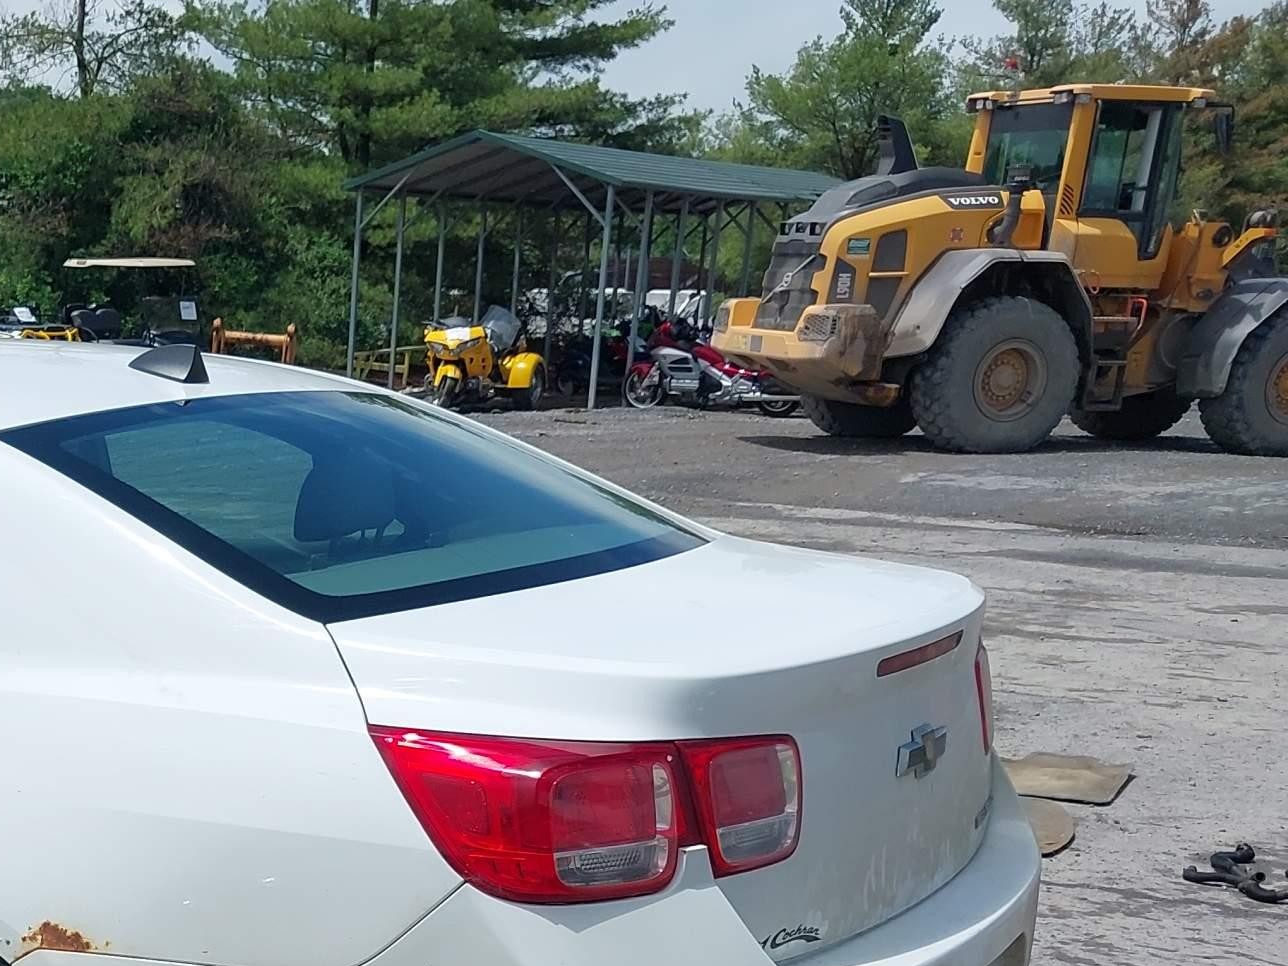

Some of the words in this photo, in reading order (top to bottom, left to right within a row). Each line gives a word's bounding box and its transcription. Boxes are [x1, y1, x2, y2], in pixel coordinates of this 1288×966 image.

[948, 196, 999, 206] VOLVO
[836, 273, 851, 299] L90H
[770, 923, 821, 949] Cochran
